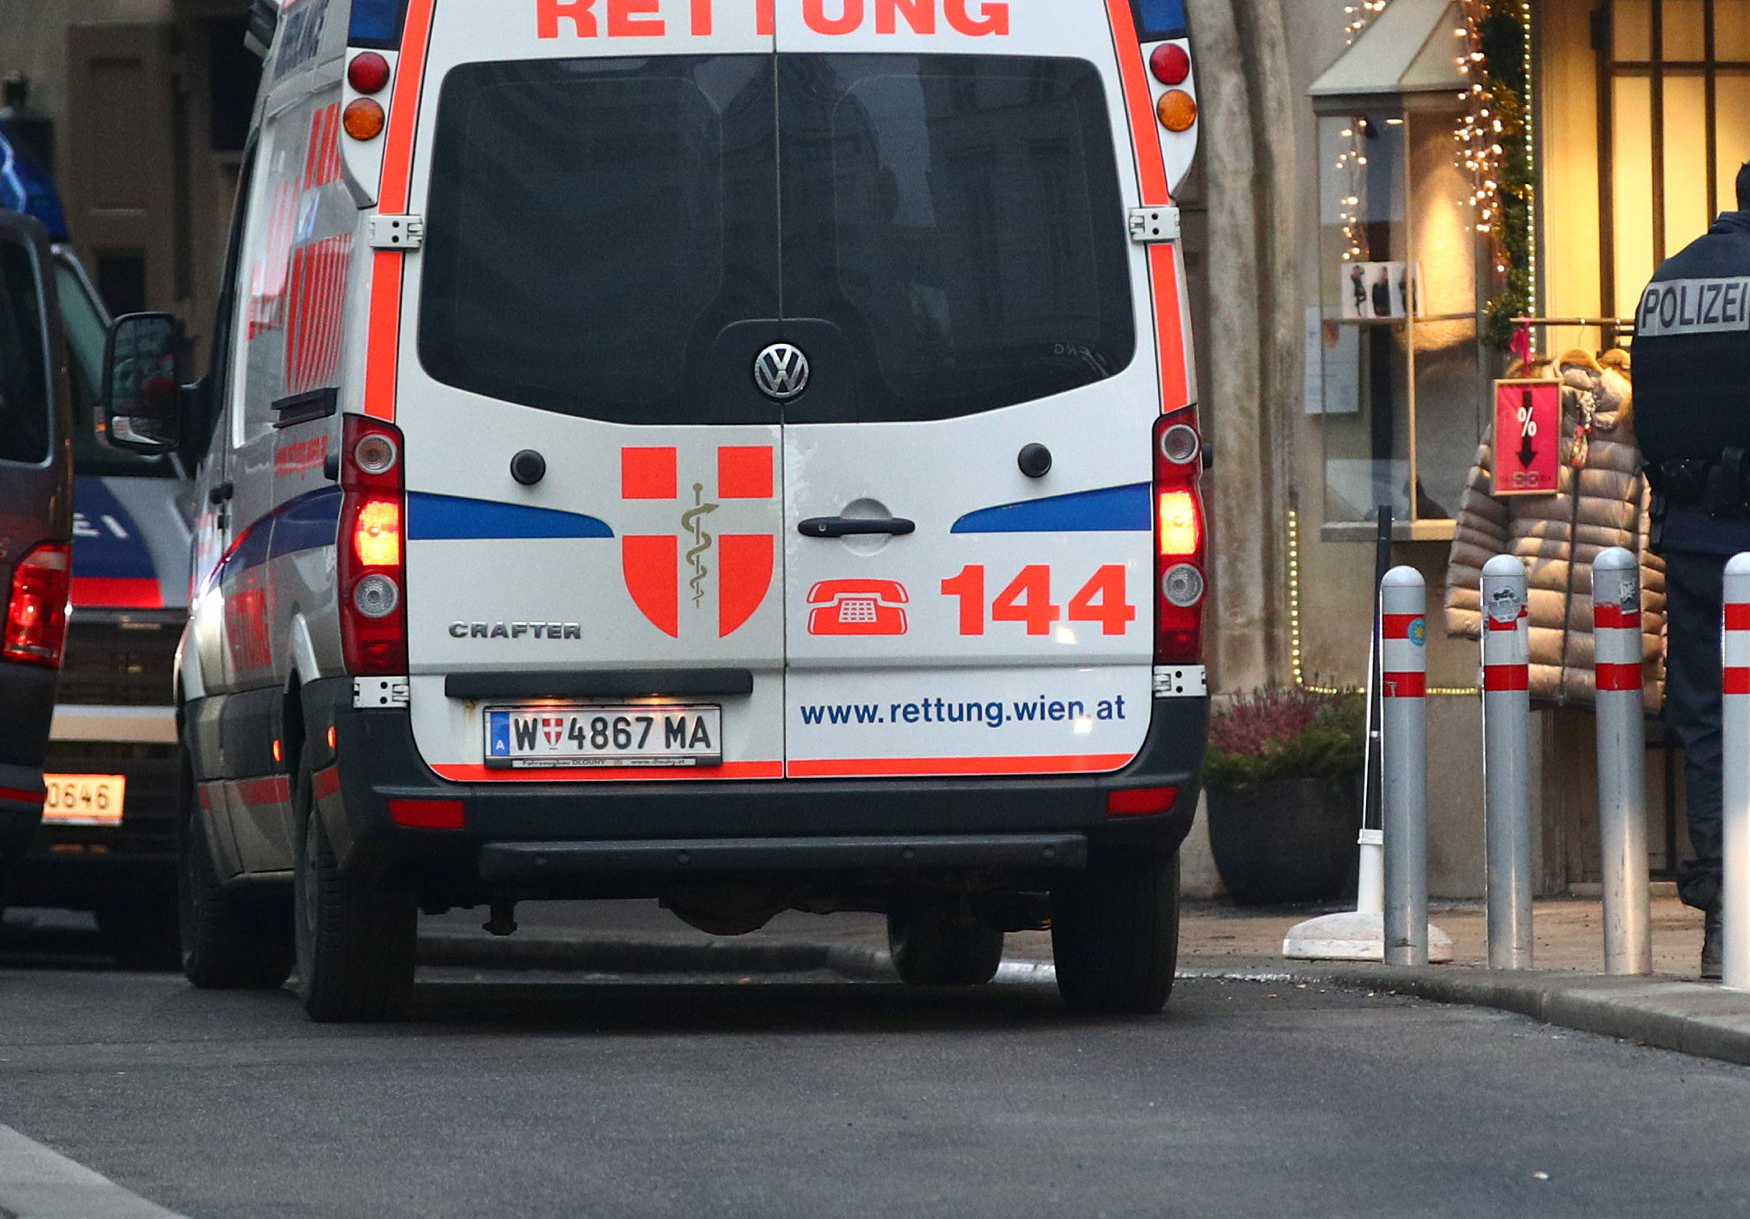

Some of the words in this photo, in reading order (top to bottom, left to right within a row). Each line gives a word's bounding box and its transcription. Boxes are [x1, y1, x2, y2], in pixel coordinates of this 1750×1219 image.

[1641, 282, 1749, 329] POLIZEI
[940, 564, 1136, 635] 144
[448, 621, 581, 639] CRAFTER
[800, 695, 1126, 727] www.rettung.wien.at
[495, 739, 505, 750] A
[514, 717, 538, 751] W
[567, 715, 654, 750] 4867
[664, 715, 711, 749] MA
